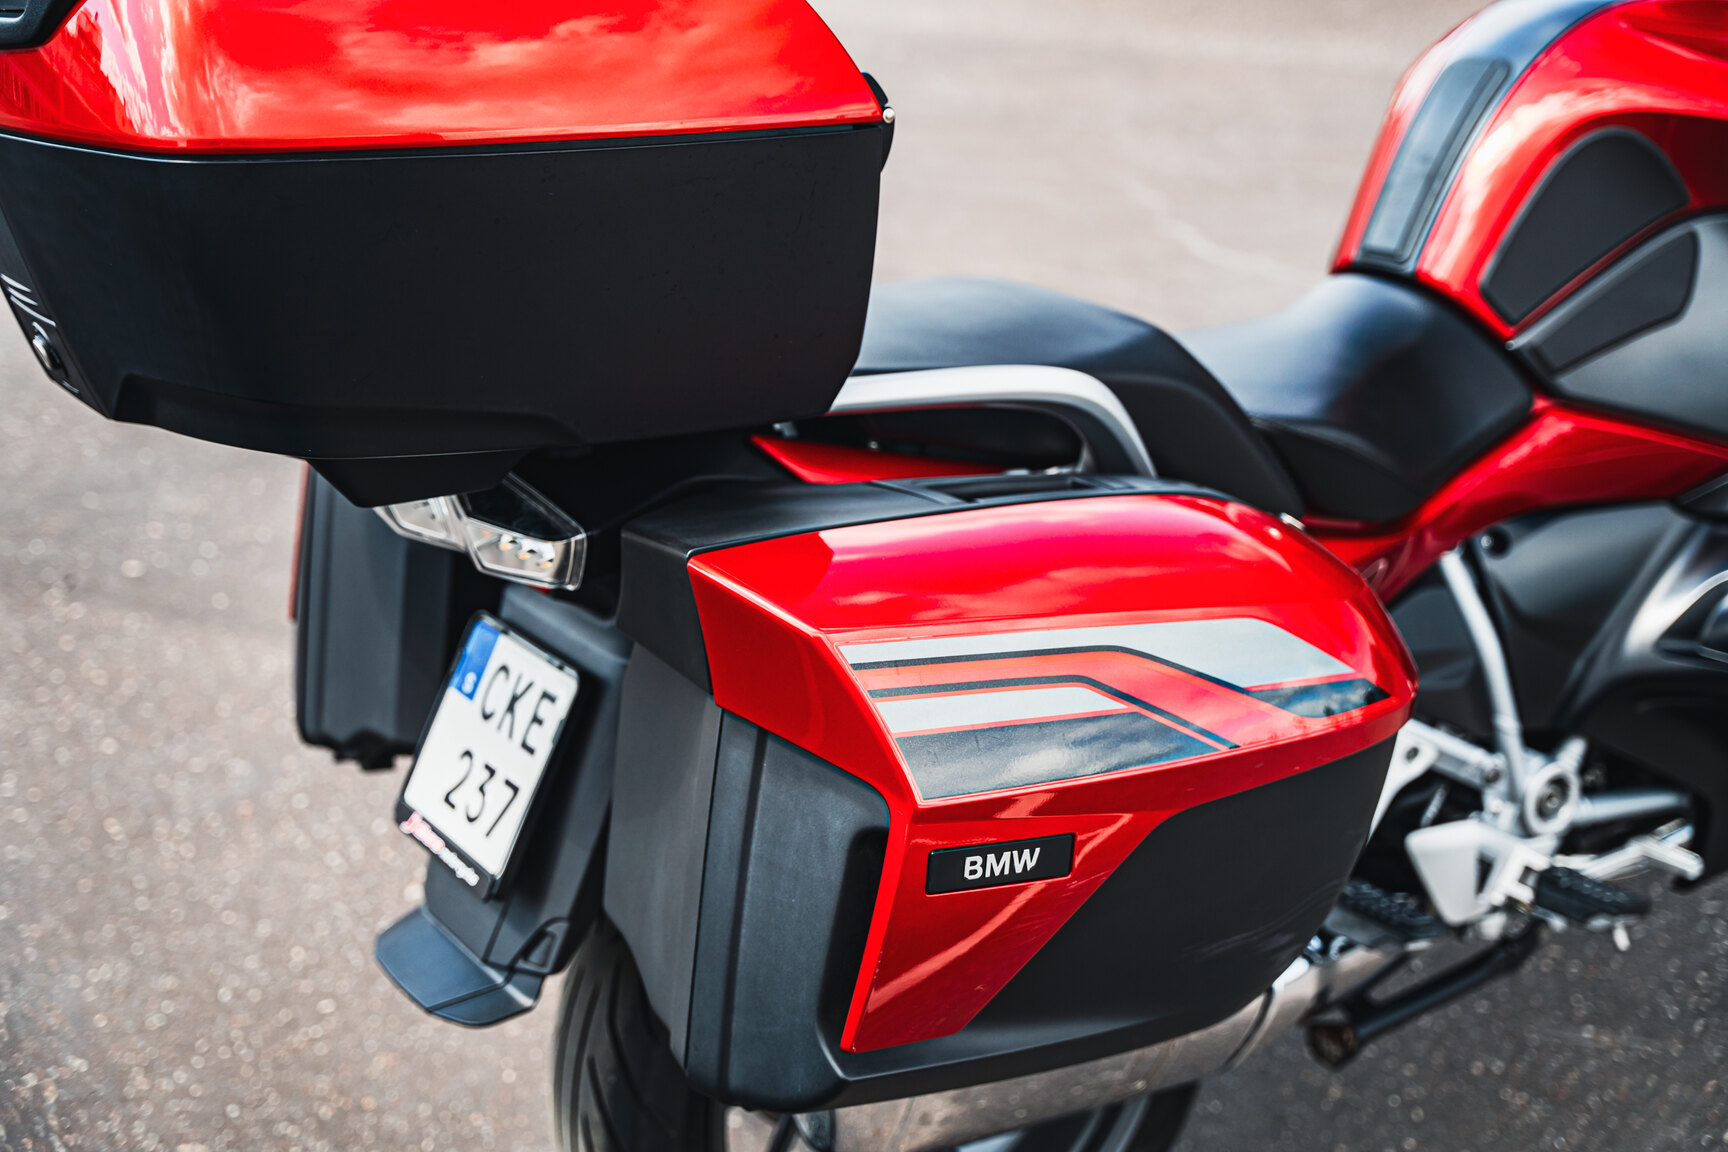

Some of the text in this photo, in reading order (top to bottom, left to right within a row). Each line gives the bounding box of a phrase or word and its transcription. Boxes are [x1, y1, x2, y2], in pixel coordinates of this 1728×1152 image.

[461, 671, 477, 693] S
[481, 664, 557, 755] CKE
[444, 750, 520, 838] 237
[964, 847, 1041, 880] BMW
